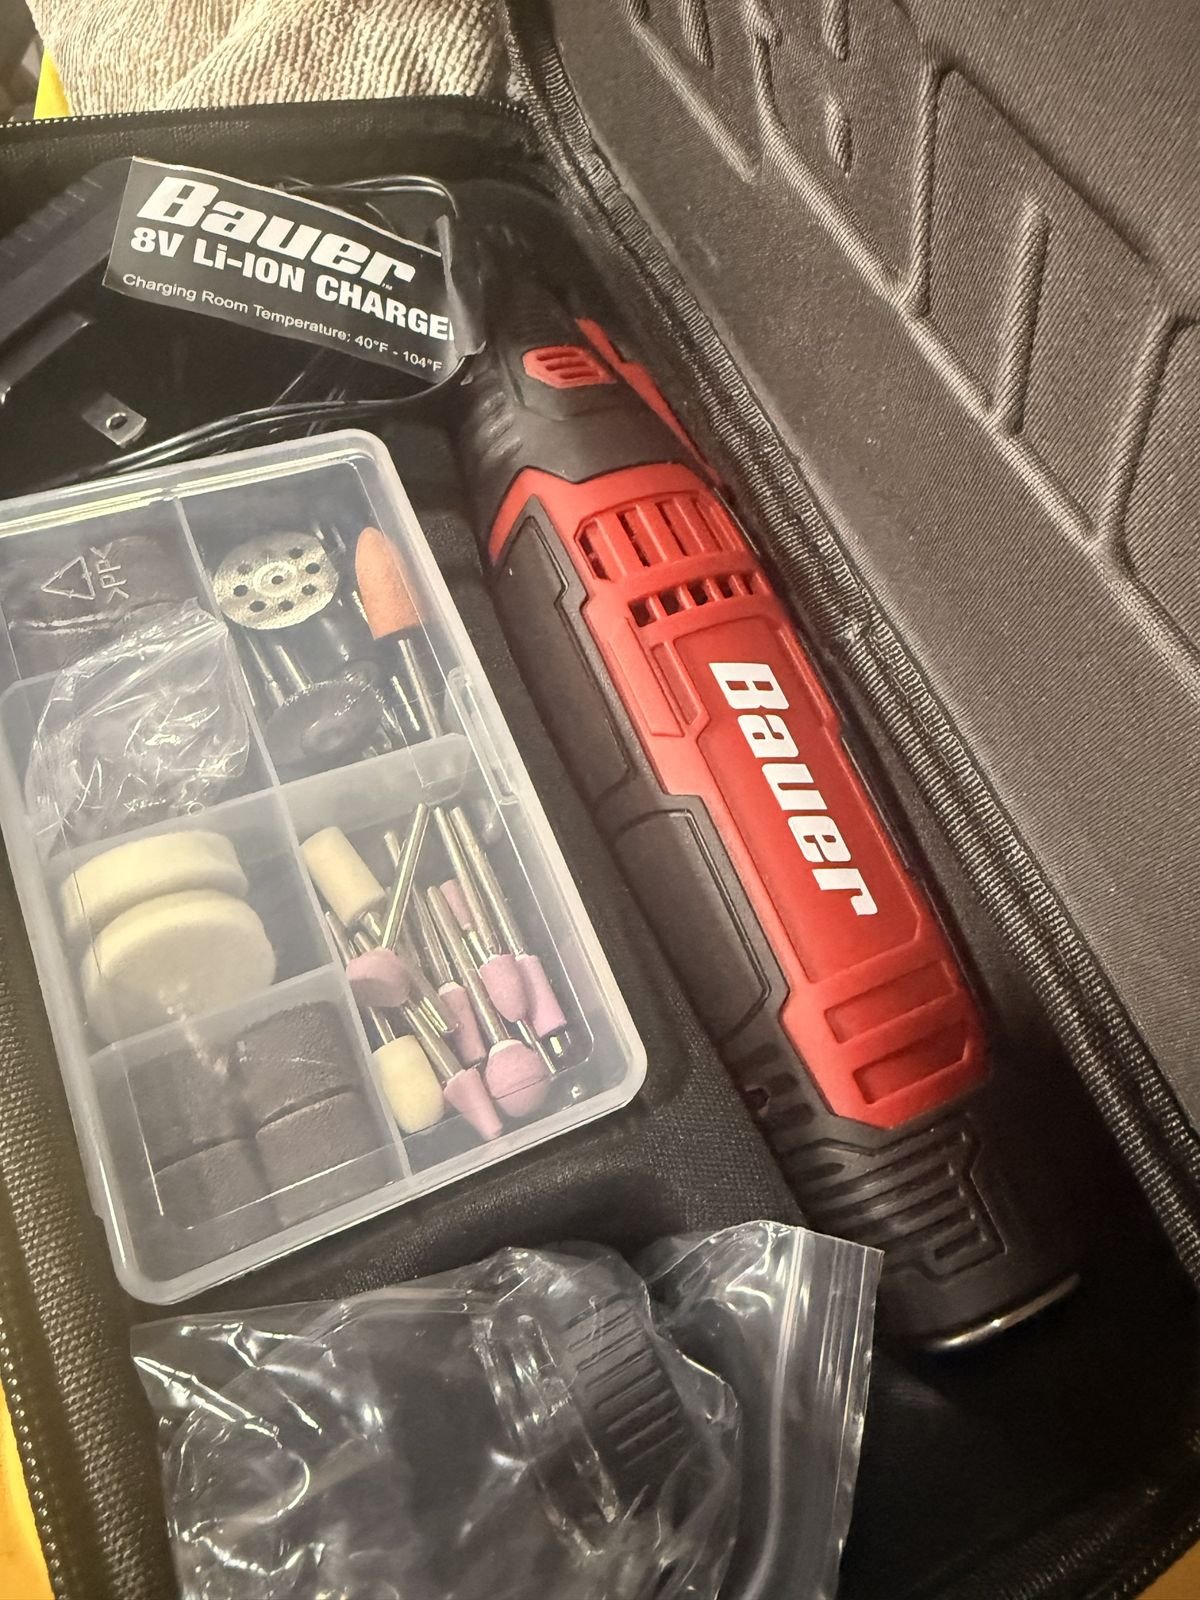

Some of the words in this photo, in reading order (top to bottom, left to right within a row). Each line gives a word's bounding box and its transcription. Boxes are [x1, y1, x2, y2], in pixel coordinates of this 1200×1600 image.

[130, 226, 185, 258] 8V
[192, 238, 306, 293] Li-ION
[136, 176, 416, 286] Bauer
[122, 273, 197, 302] Charging
[201, 290, 249, 314] Room
[708, 662, 878, 916] Bauer
